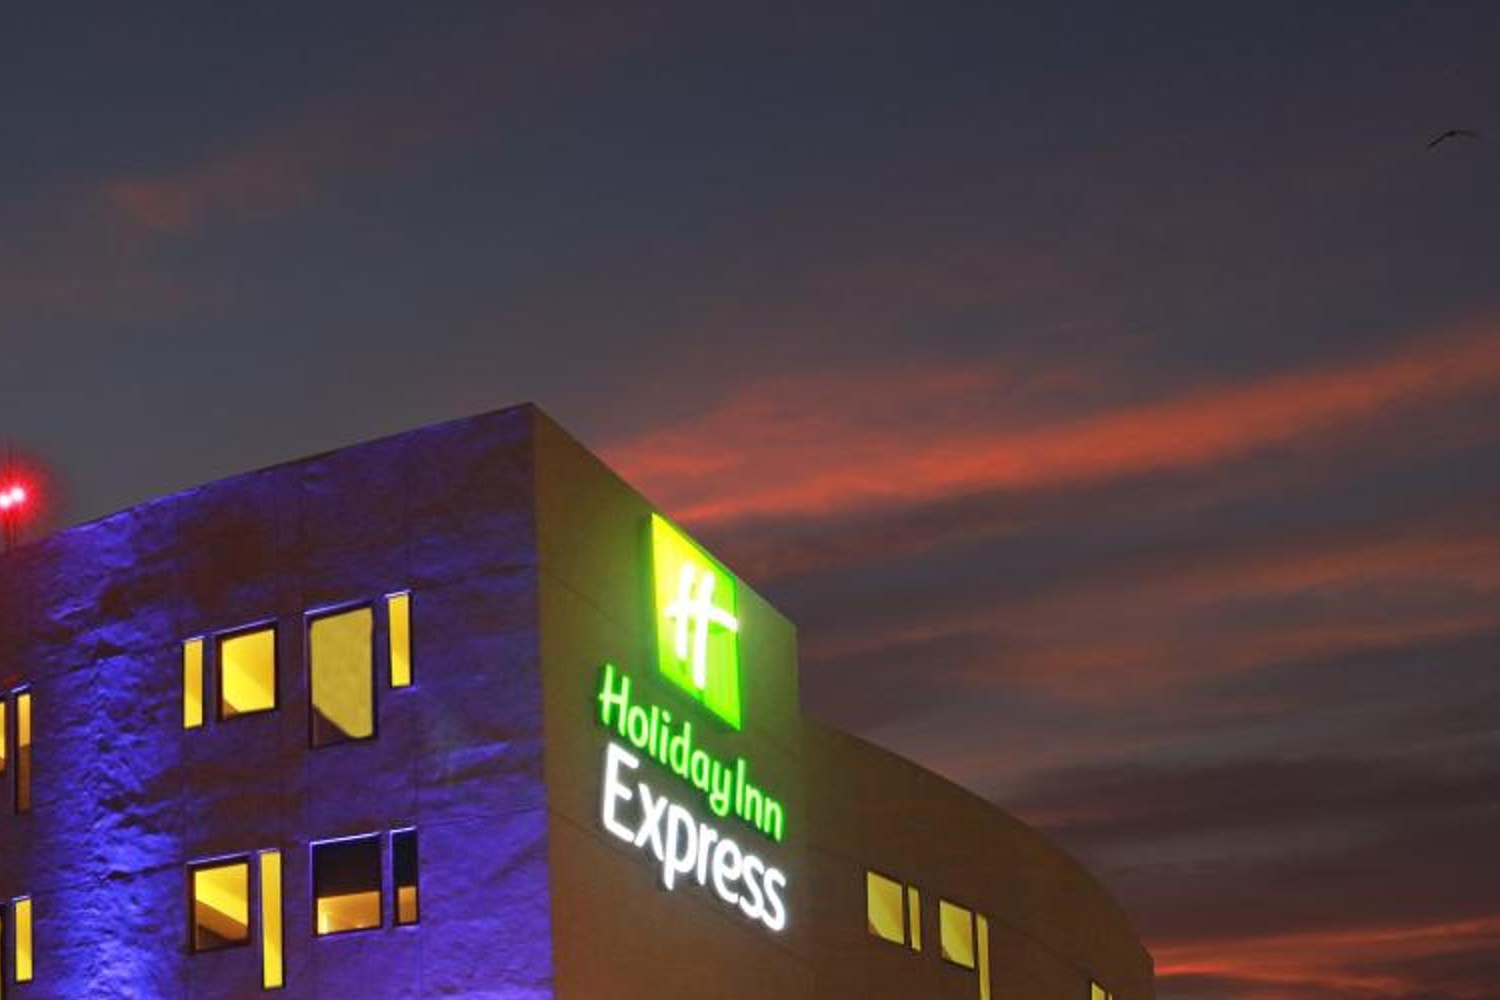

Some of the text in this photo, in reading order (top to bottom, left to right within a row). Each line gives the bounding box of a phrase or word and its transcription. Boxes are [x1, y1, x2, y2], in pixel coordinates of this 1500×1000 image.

[599, 664, 784, 842] Holiday Inn
[603, 742, 787, 931] Express
